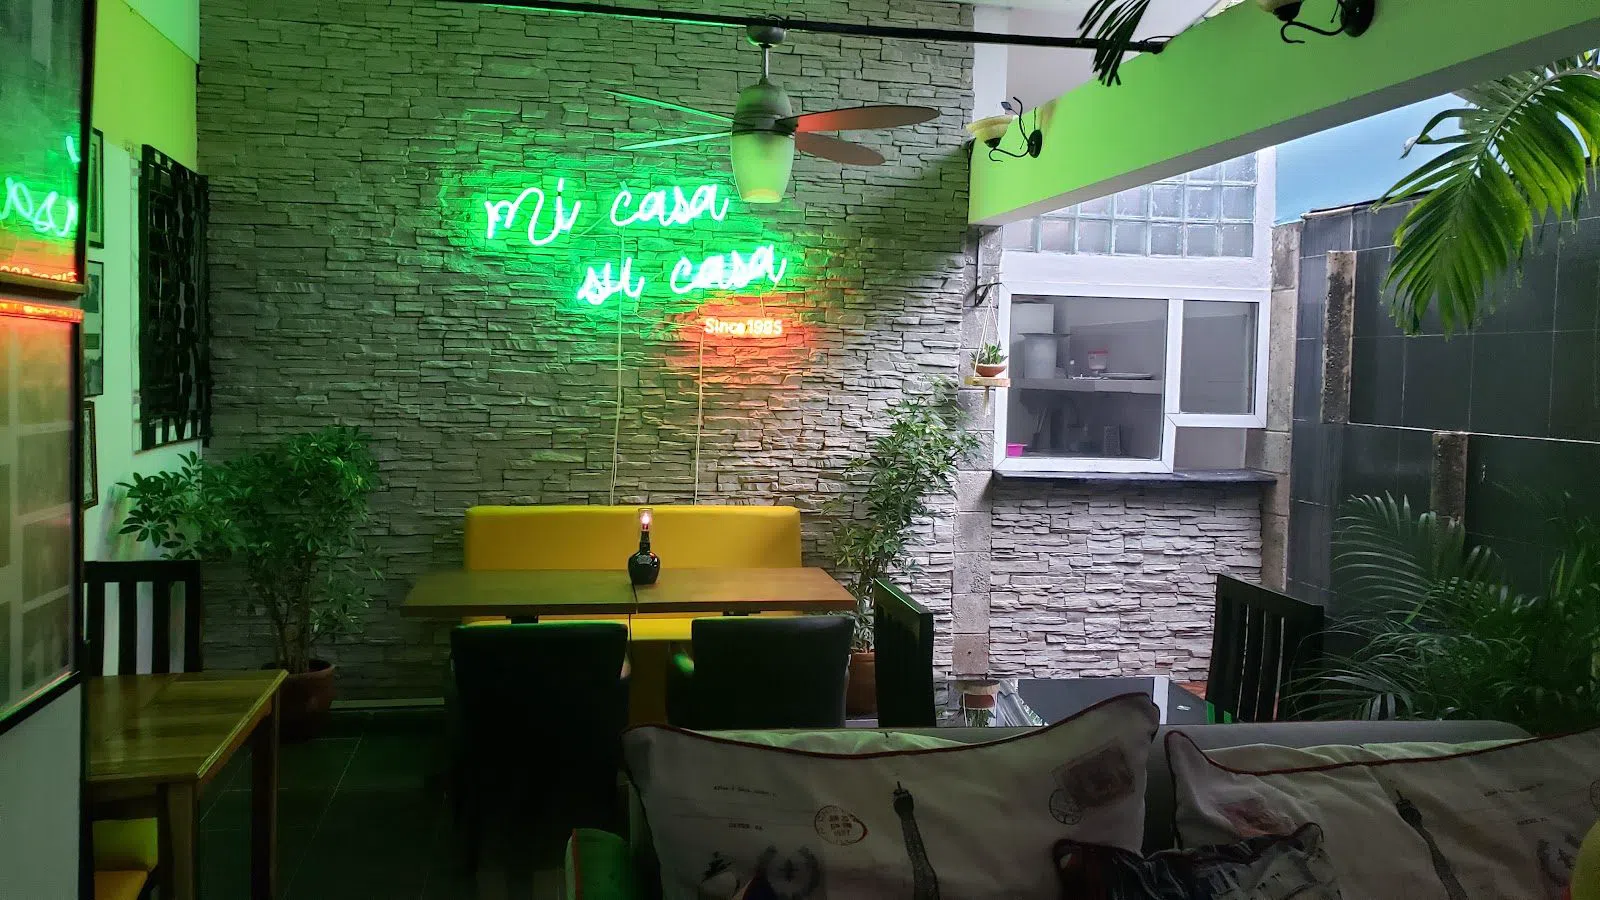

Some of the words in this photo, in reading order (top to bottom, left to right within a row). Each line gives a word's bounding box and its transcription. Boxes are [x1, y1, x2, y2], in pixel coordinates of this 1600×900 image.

[609, 184, 729, 226] casa
[576, 257, 645, 305] su
[669, 244, 787, 293] casa
[704, 317, 745, 335] Since
